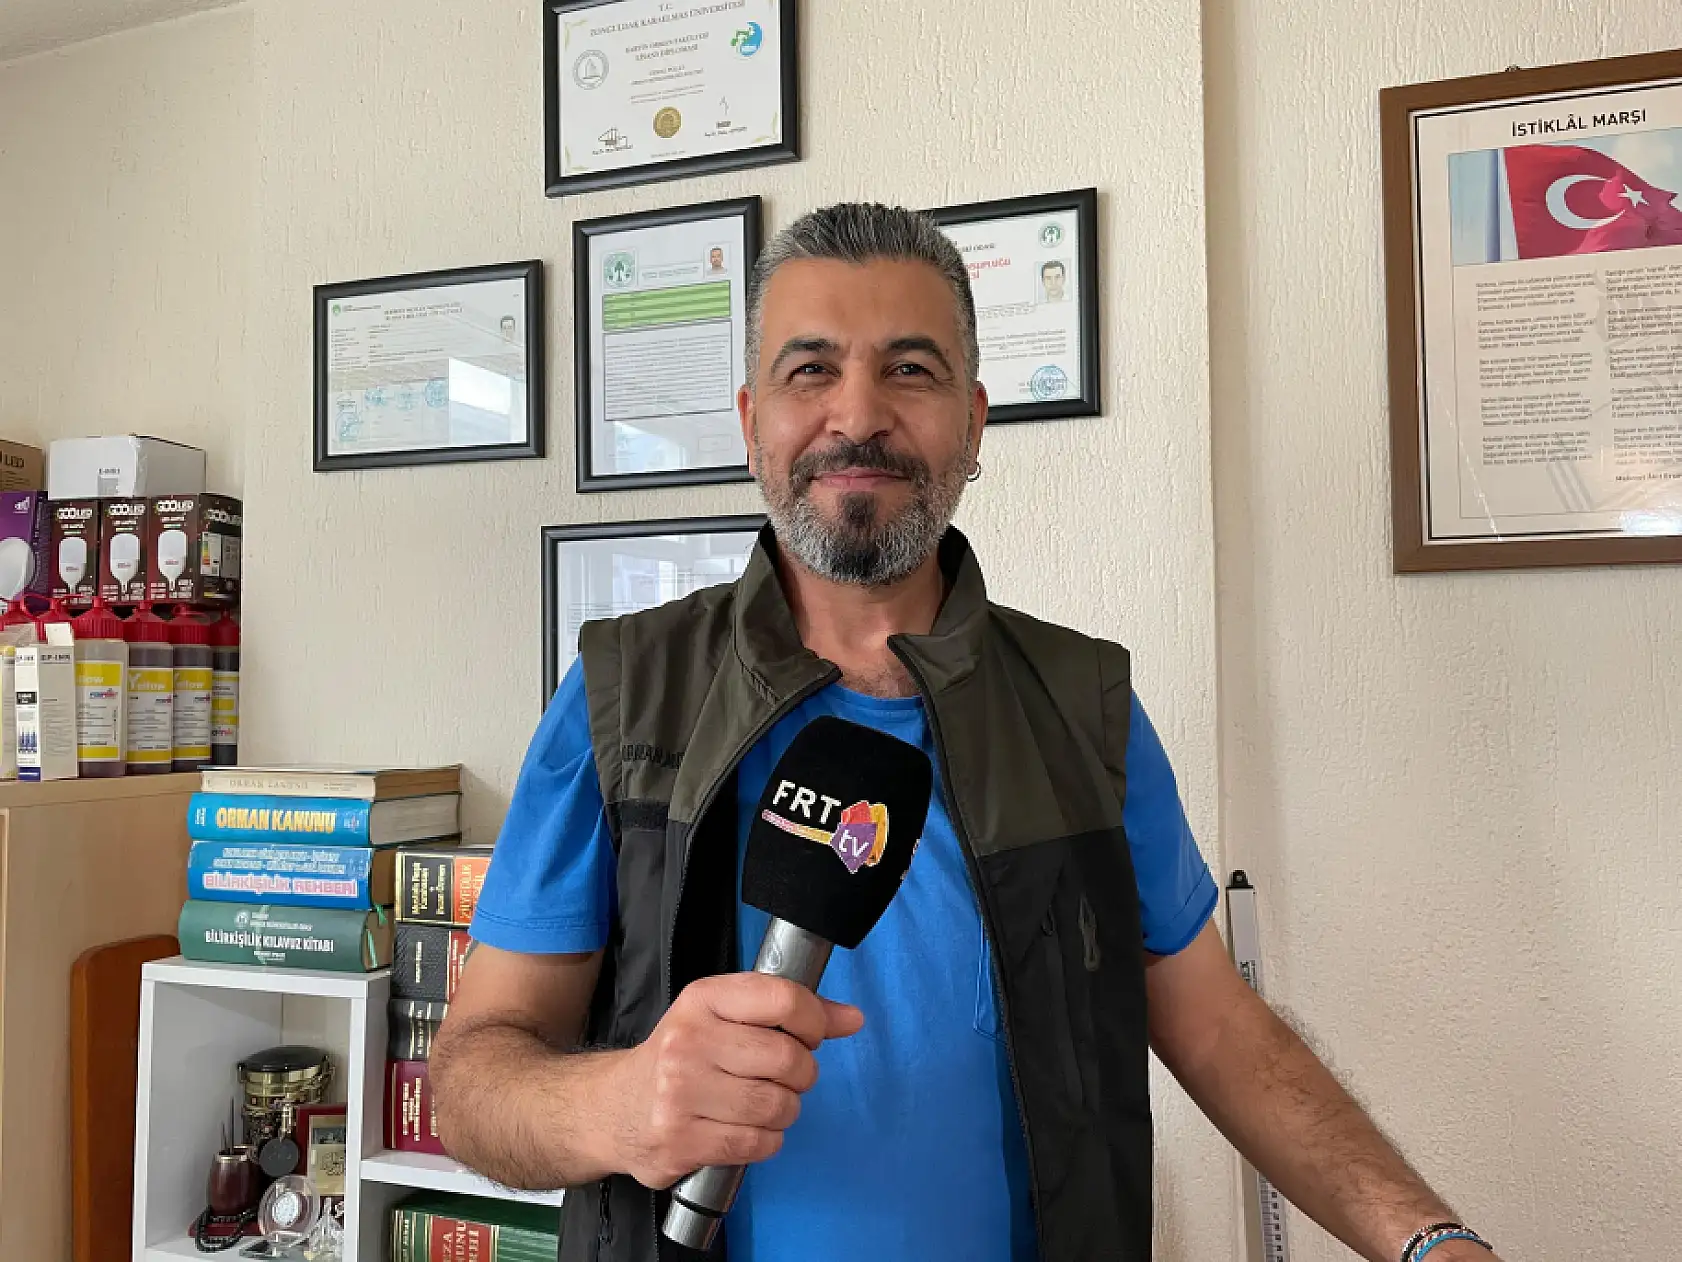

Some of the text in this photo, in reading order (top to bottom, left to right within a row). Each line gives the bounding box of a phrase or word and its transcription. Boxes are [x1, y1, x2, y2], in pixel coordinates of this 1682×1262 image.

[1512, 108, 1646, 137] İSTİKLÂL MARŞI
[772, 779, 842, 824] FRT
[216, 807, 336, 834] ORMAN KANUNU
[837, 829, 870, 858] tv
[203, 870, 291, 896] BİLİRKİŞİLİK
[205, 928, 334, 953] BİLİRKİŞİLİK KILAVUZ KİTABI
